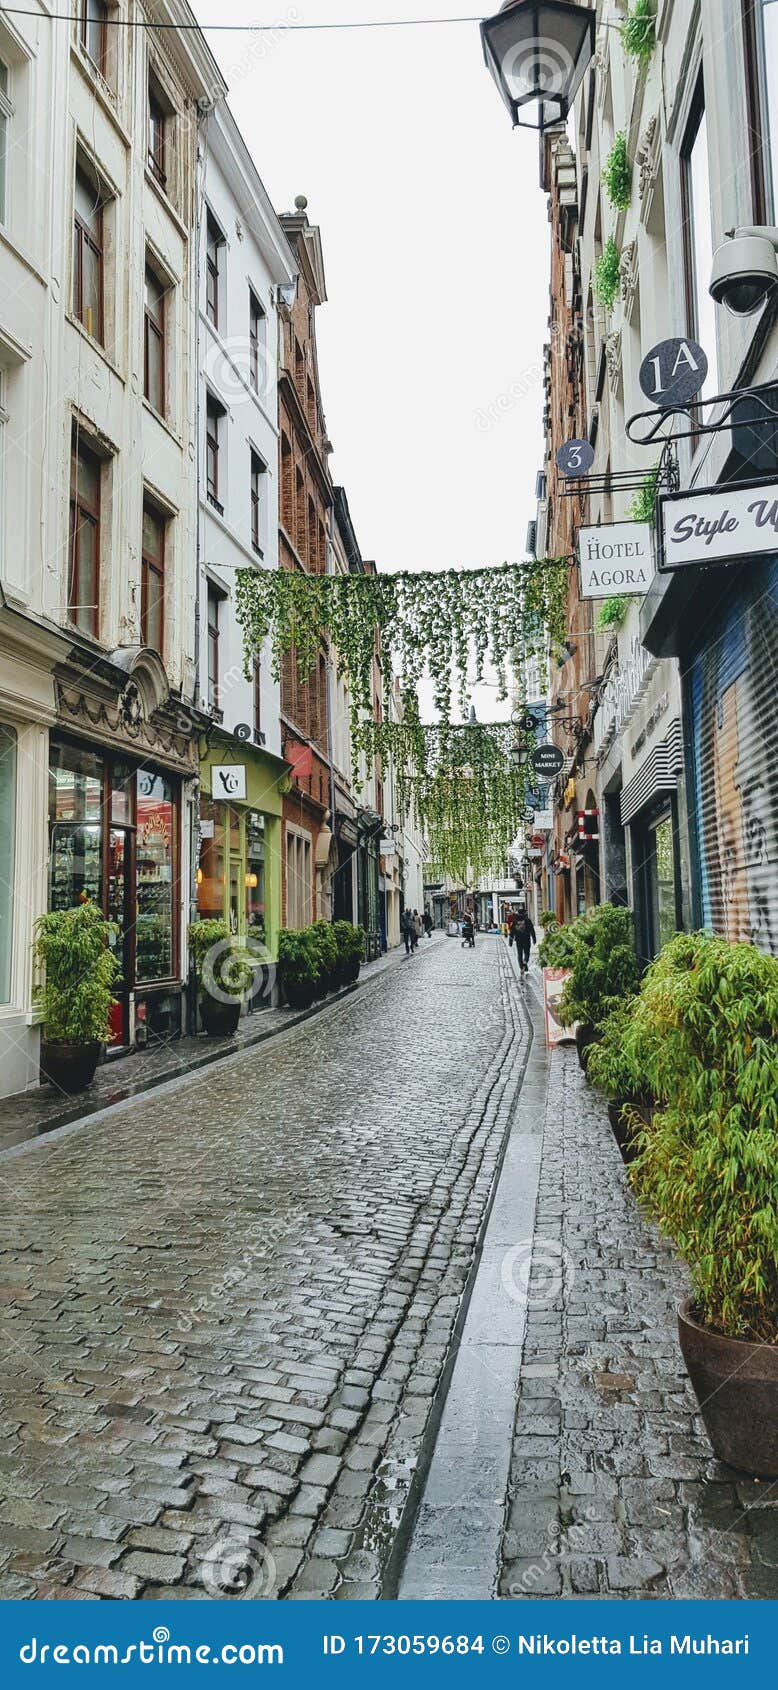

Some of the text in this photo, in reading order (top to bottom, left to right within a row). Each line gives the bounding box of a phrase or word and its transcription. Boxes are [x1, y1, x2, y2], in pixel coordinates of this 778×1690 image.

[648, 341, 699, 395] 1A
[567, 446, 582, 468] 3
[670, 510, 739, 545] Style
[587, 542, 644, 560] HOTEL
[589, 568, 646, 587] AGORA
[525, 716, 533, 728] 5
[237, 726, 245, 738] 6
